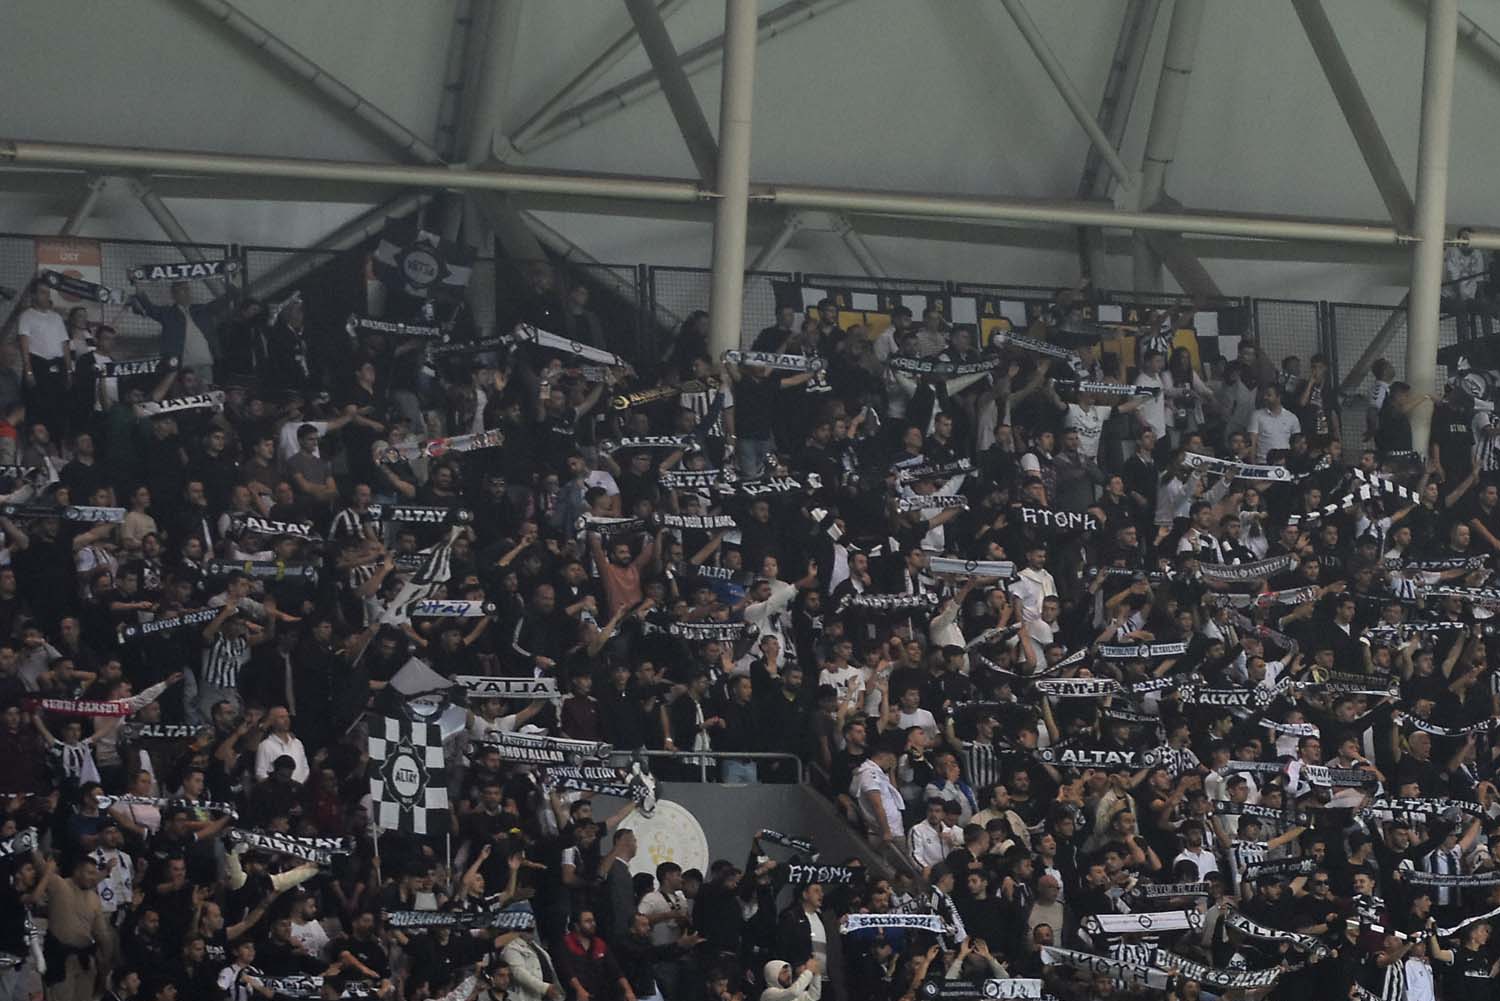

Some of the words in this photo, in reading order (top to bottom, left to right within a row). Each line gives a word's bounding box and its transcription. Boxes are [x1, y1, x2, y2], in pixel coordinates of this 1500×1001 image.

[150, 261, 220, 279] ALTAY
[756, 351, 802, 366] ALTAY
[112, 359, 160, 377] ALTAY
[391, 508, 448, 523] ALTAY
[246, 517, 311, 535] ALTAY
[697, 565, 736, 580] ALTAY
[1199, 693, 1250, 706] ALTAY
[139, 724, 204, 738] ALTAY
[1061, 748, 1136, 763] ALTAY
[395, 768, 419, 783] ALTAY
[257, 837, 314, 861] ALTAY
[1229, 966, 1281, 987] ALTAY
